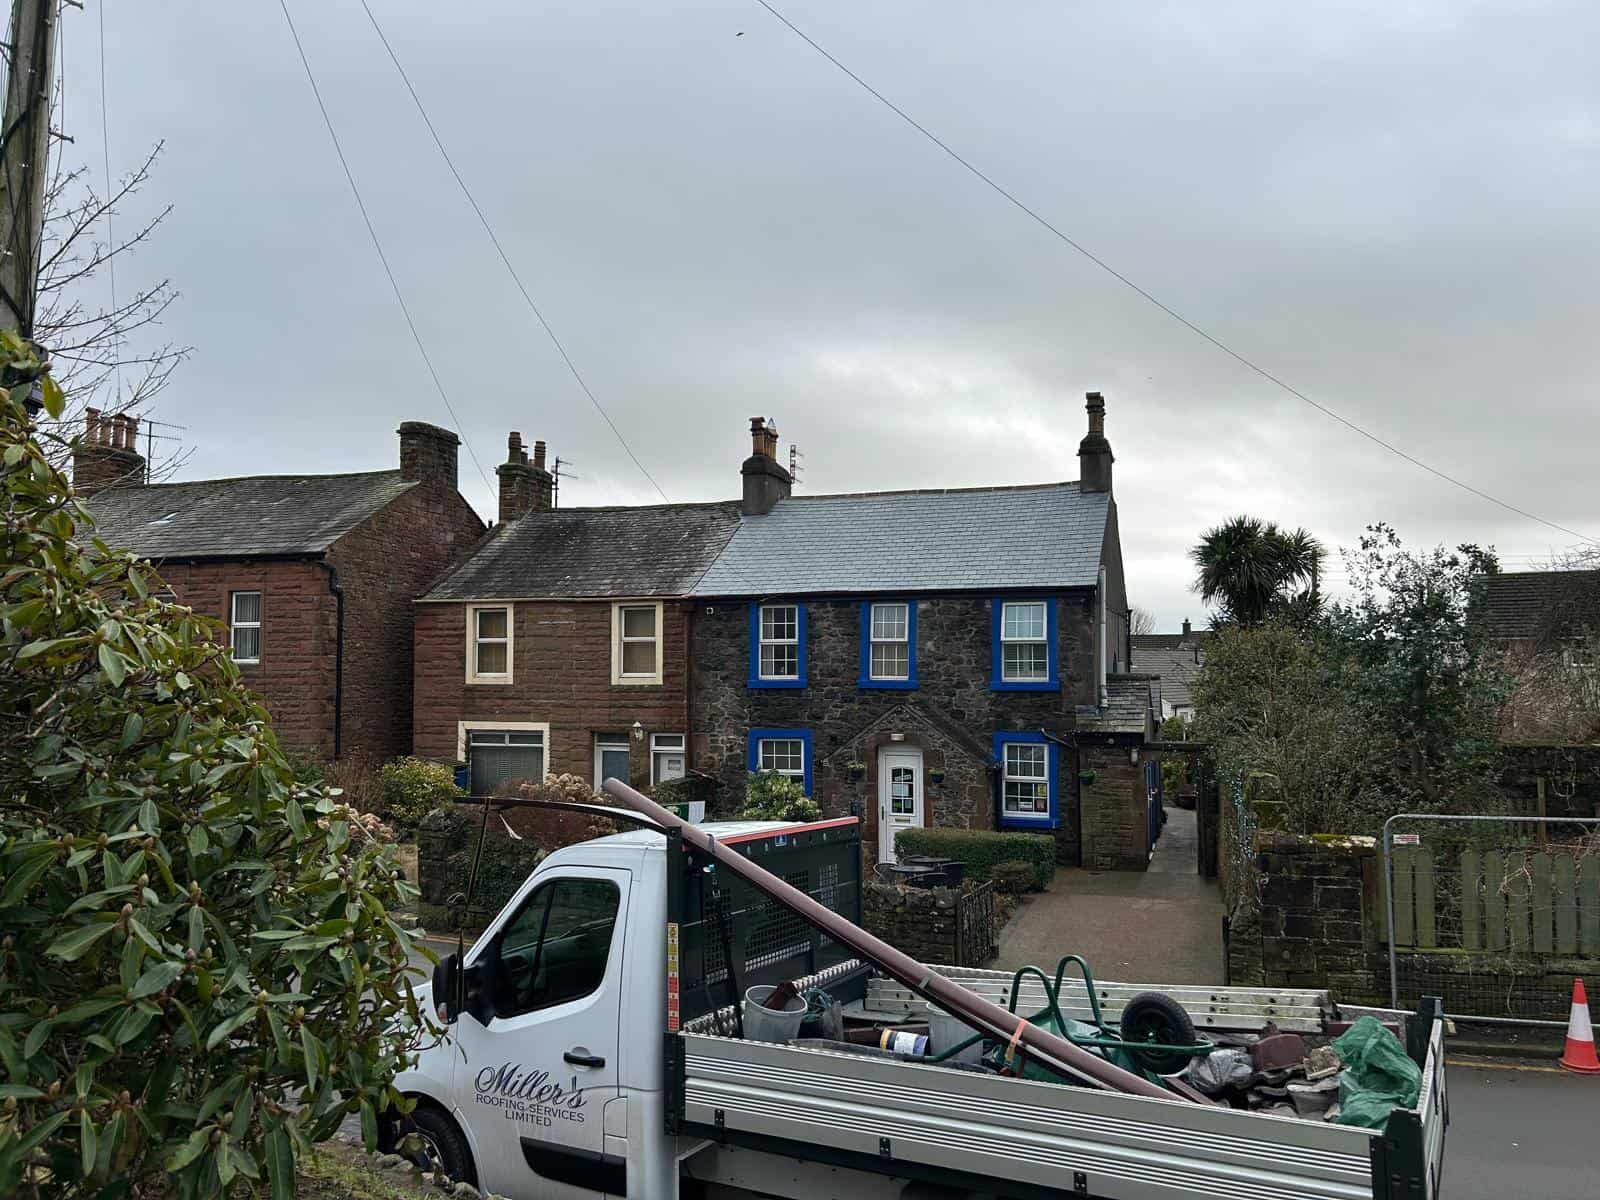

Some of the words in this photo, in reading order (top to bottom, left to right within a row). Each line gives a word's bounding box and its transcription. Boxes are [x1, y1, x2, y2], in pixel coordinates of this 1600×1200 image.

[475, 1061, 588, 1109] Miller's
[475, 1093, 526, 1111] ROOFING
[528, 1103, 585, 1122] SERVICES
[505, 1110, 552, 1127] LIMITED
